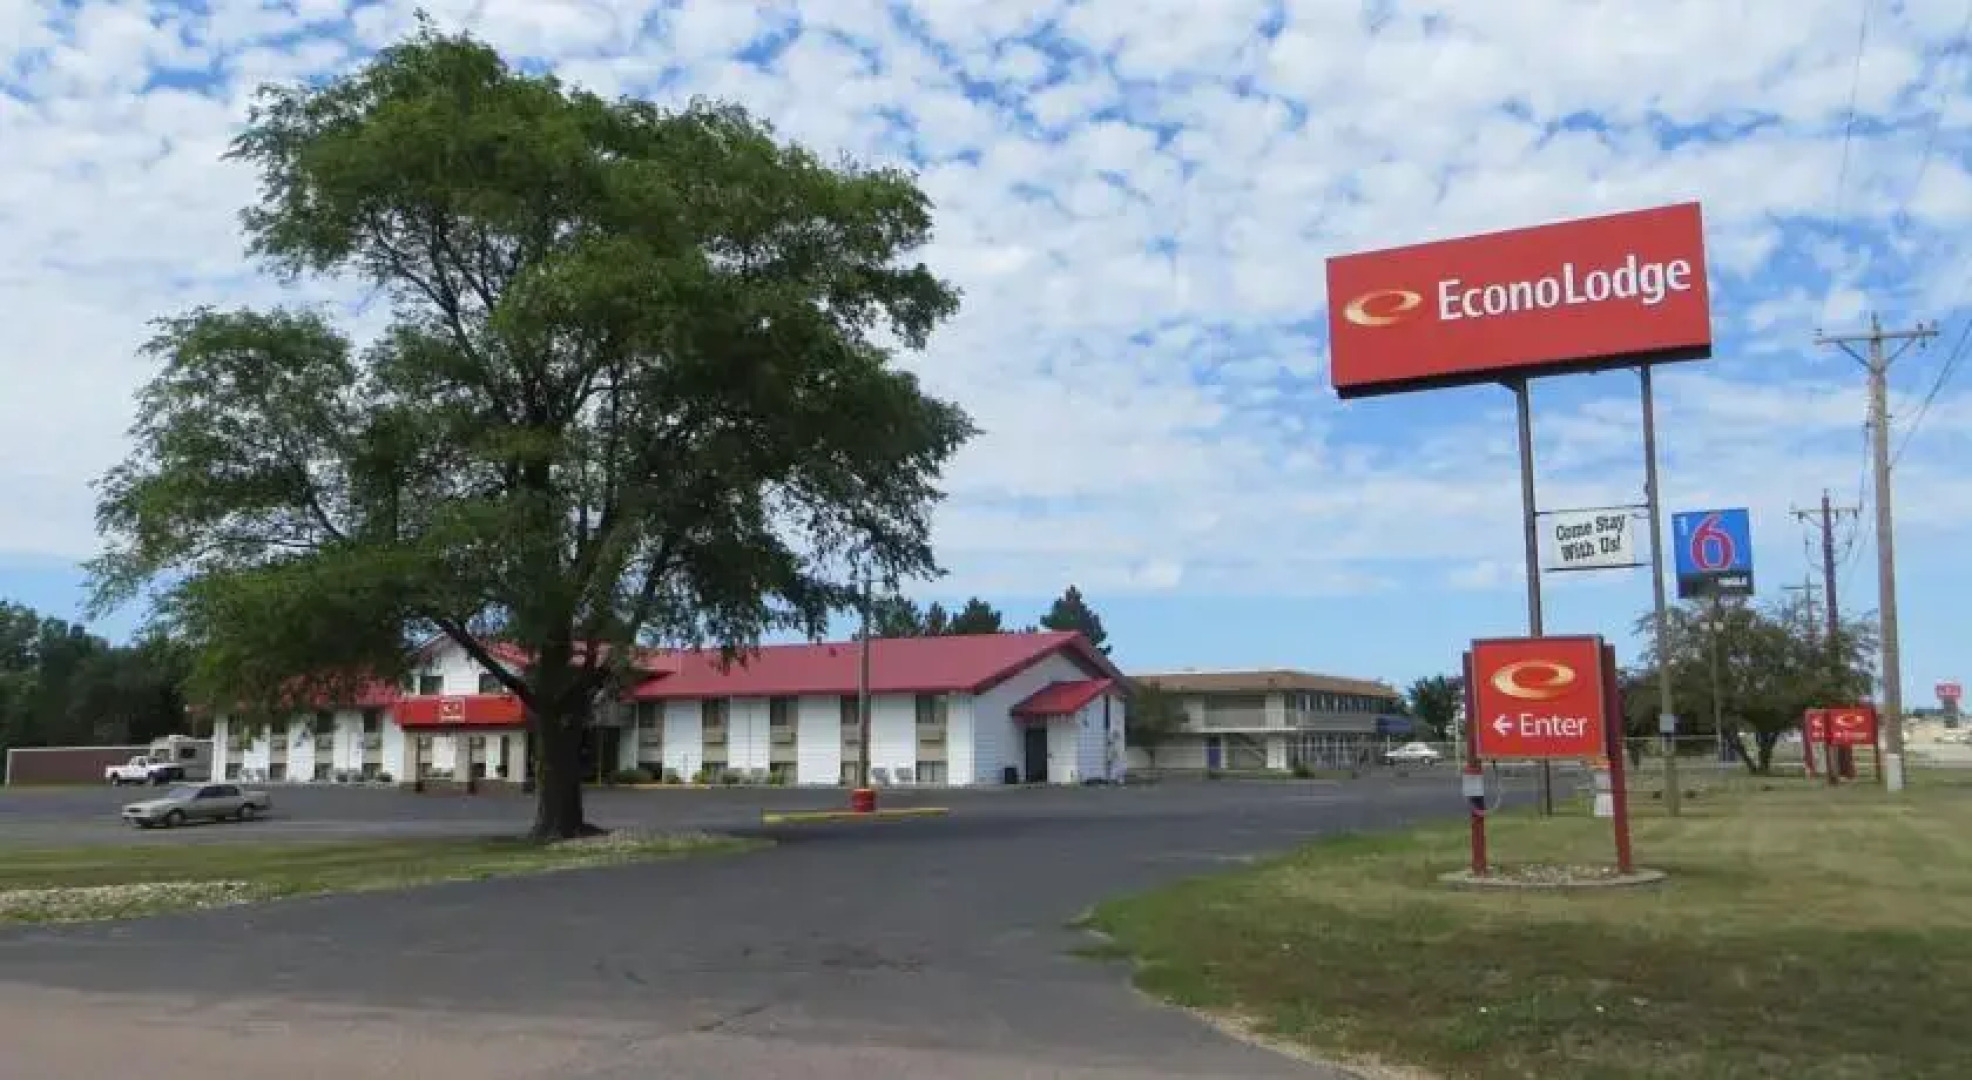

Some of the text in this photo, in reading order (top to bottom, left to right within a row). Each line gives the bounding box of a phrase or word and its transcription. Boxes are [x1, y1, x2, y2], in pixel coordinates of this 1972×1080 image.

[1556, 514, 1625, 540] Come Stay
[1561, 541, 1594, 561] With
[1690, 514, 1735, 571] 6
[1520, 713, 1587, 738] Enter
